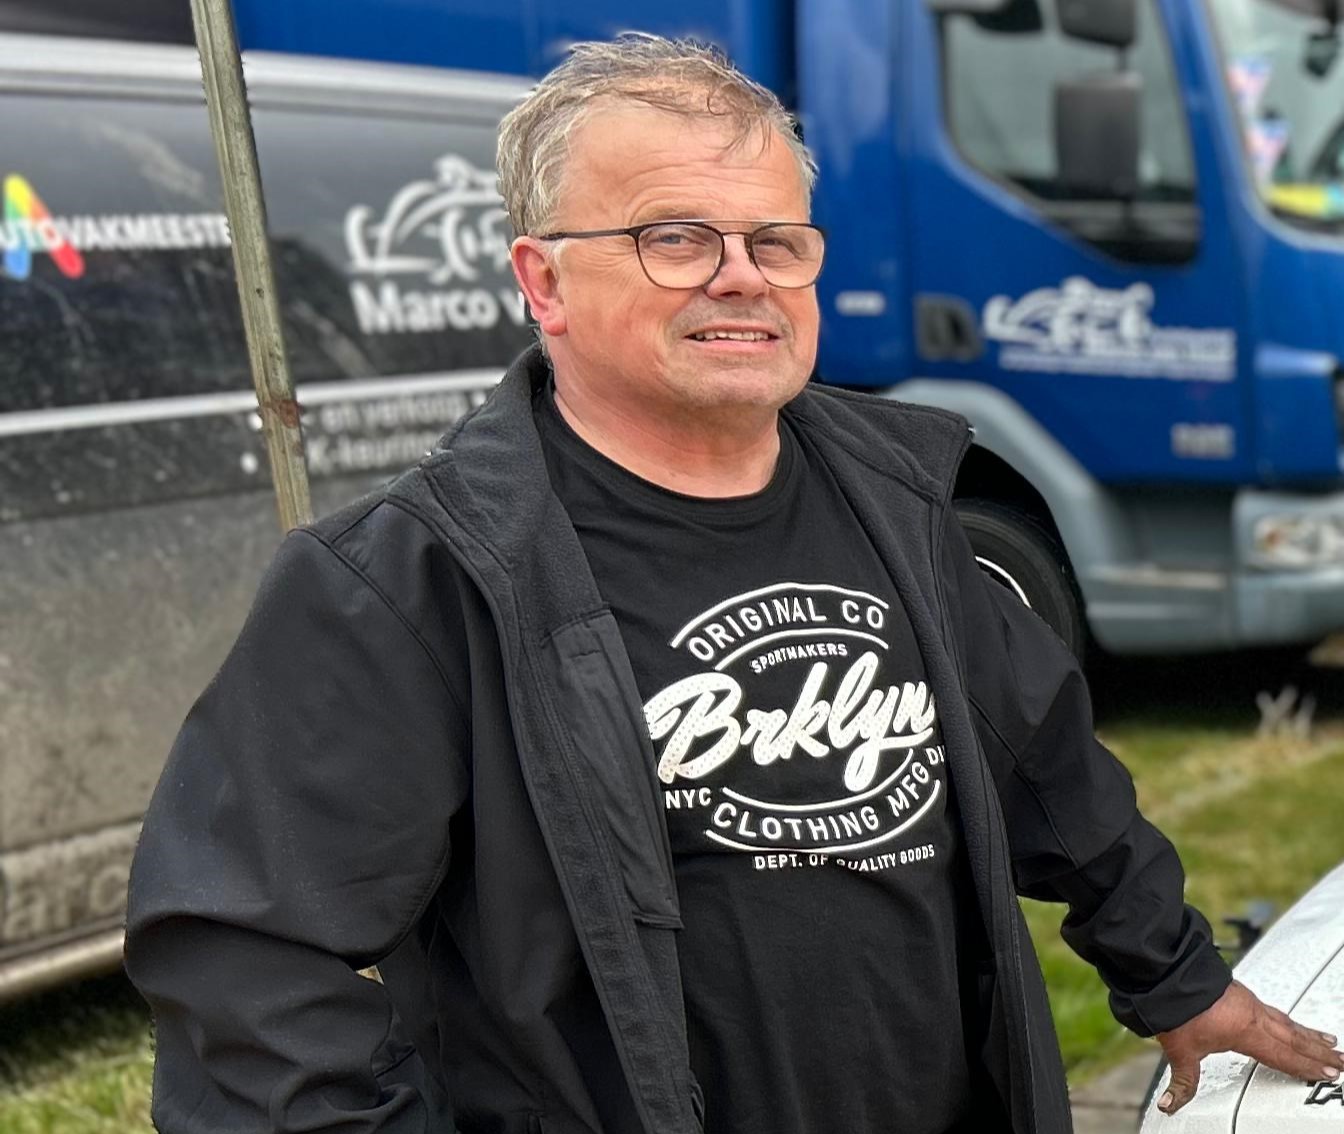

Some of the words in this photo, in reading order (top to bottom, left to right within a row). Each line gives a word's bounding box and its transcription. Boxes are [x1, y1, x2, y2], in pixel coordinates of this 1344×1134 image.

[350, 280, 499, 334] Marco
[688, 597, 827, 661] ORIGINAL
[842, 599, 885, 629] CO
[751, 643, 848, 674] SPORTMAKERS
[643, 651, 936, 792] Brklyn
[665, 787, 712, 809] NYC
[712, 802, 879, 842] CLOTHING
[886, 762, 929, 818] MFG
[754, 854, 803, 870] DEPT.
[809, 854, 829, 866] OF
